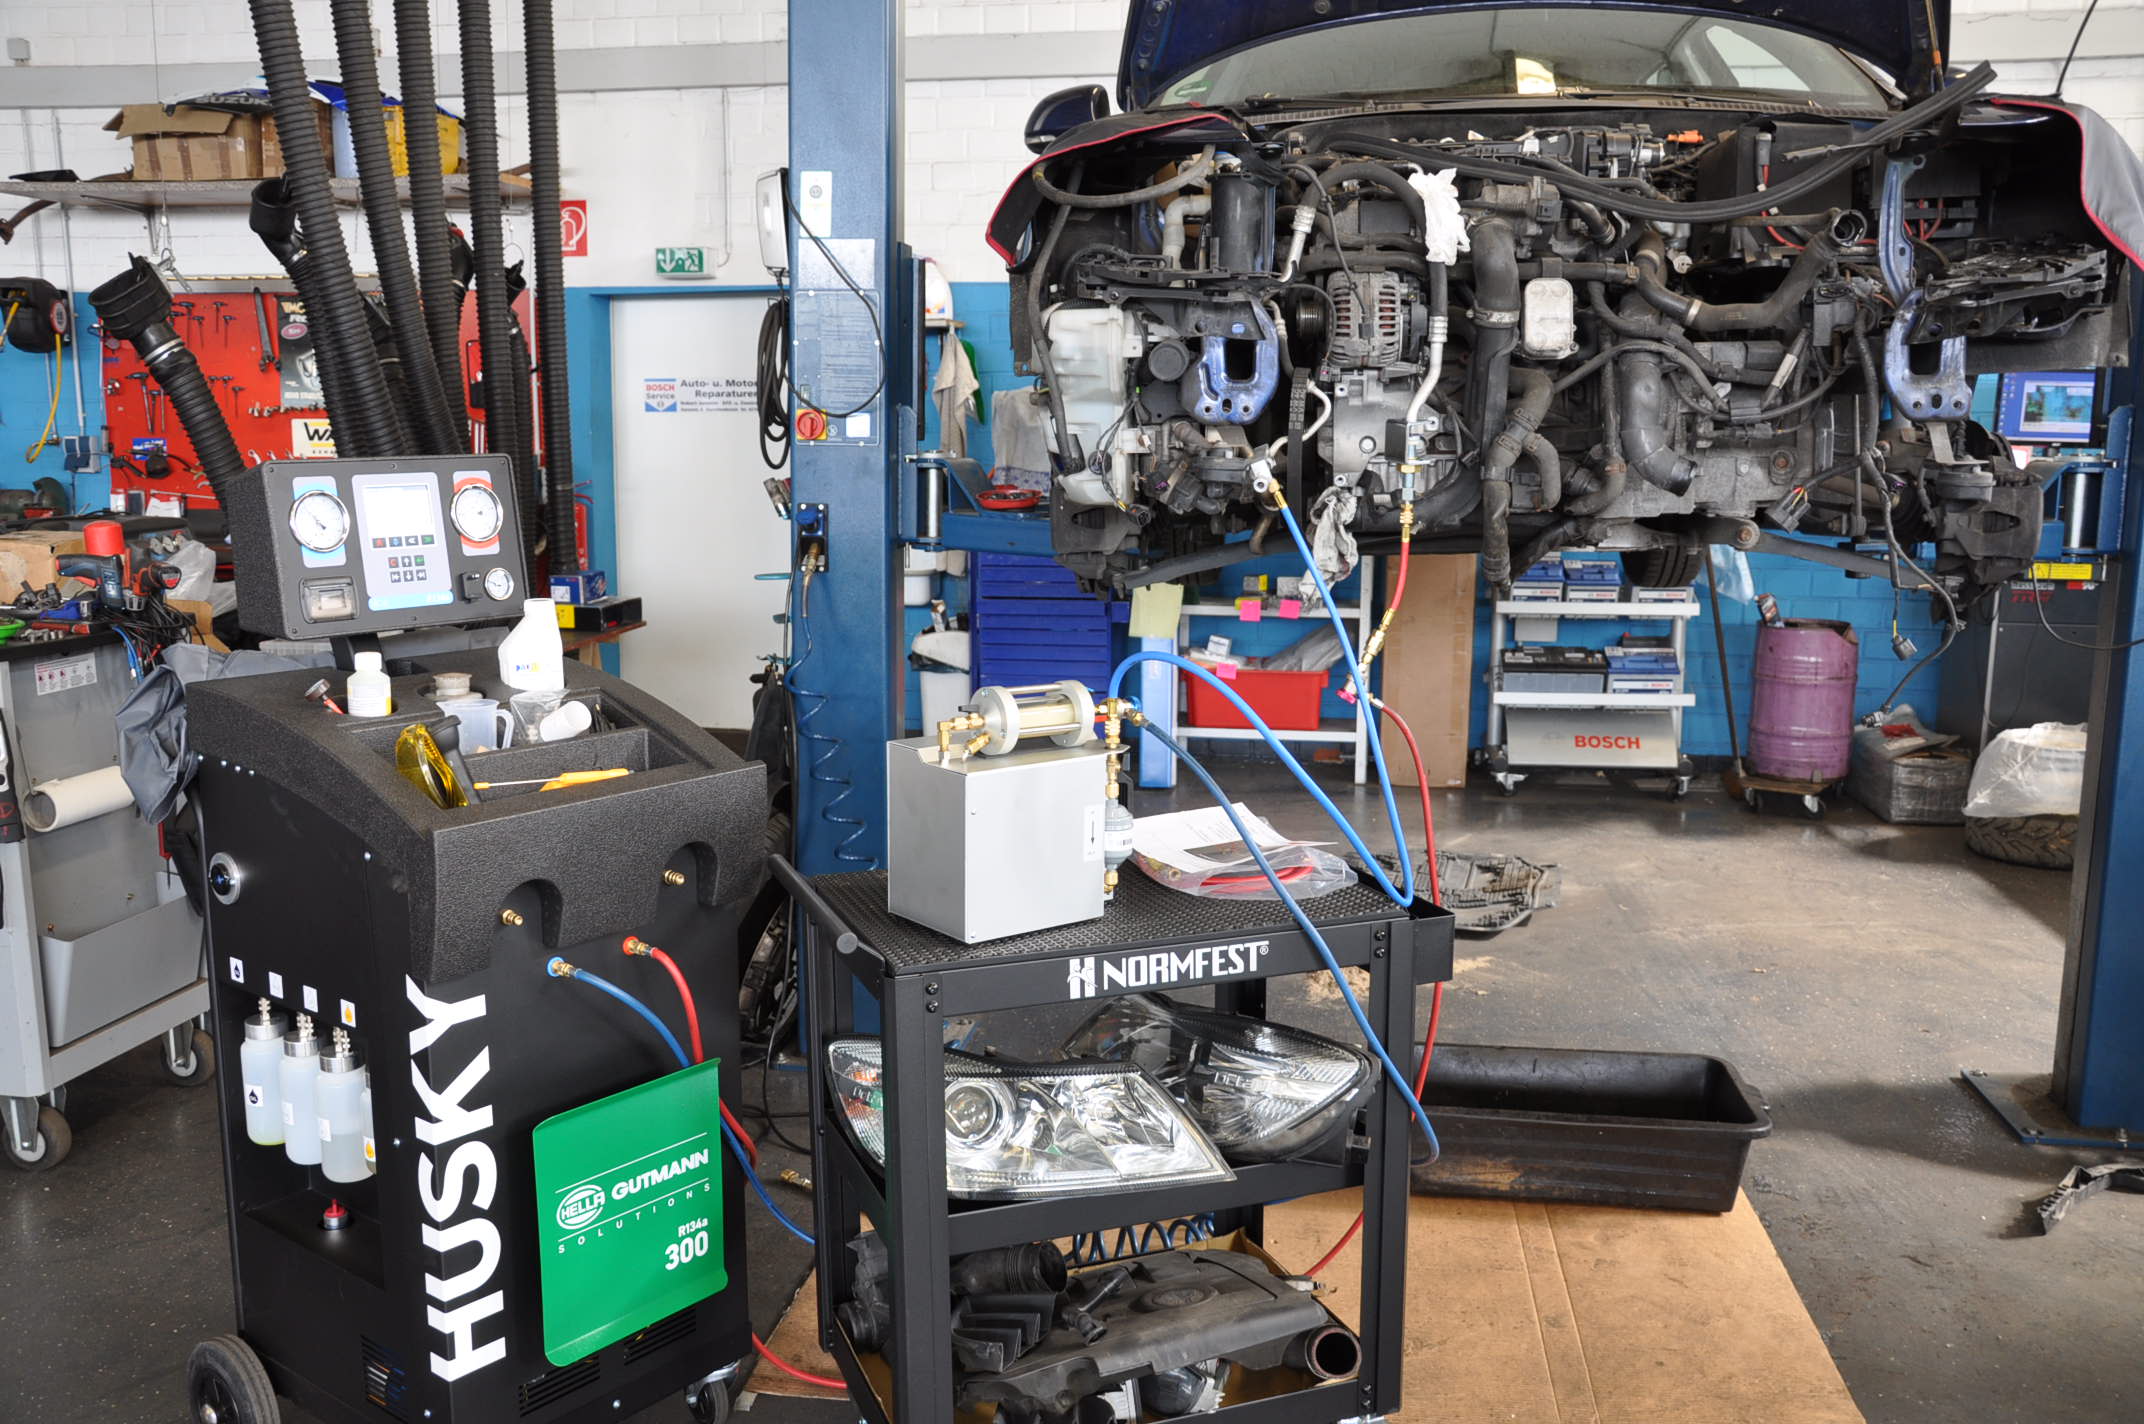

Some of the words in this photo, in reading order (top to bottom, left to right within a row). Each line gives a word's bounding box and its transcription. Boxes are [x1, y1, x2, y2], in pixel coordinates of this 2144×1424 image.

[645, 383, 676, 392] BOSCH
[680, 380, 710, 388] Auto-
[712, 380, 723, 388] u.
[645, 392, 676, 400] Service
[1574, 735, 1641, 749] BOSCH
[405, 973, 507, 1382] HUSKY
[560, 1190, 606, 1221] HELLA
[611, 1148, 709, 1201] GUTMANN
[558, 1183, 710, 1254] SOLUTIONS
[677, 1217, 709, 1238] R134a
[664, 1230, 709, 1271] 300
